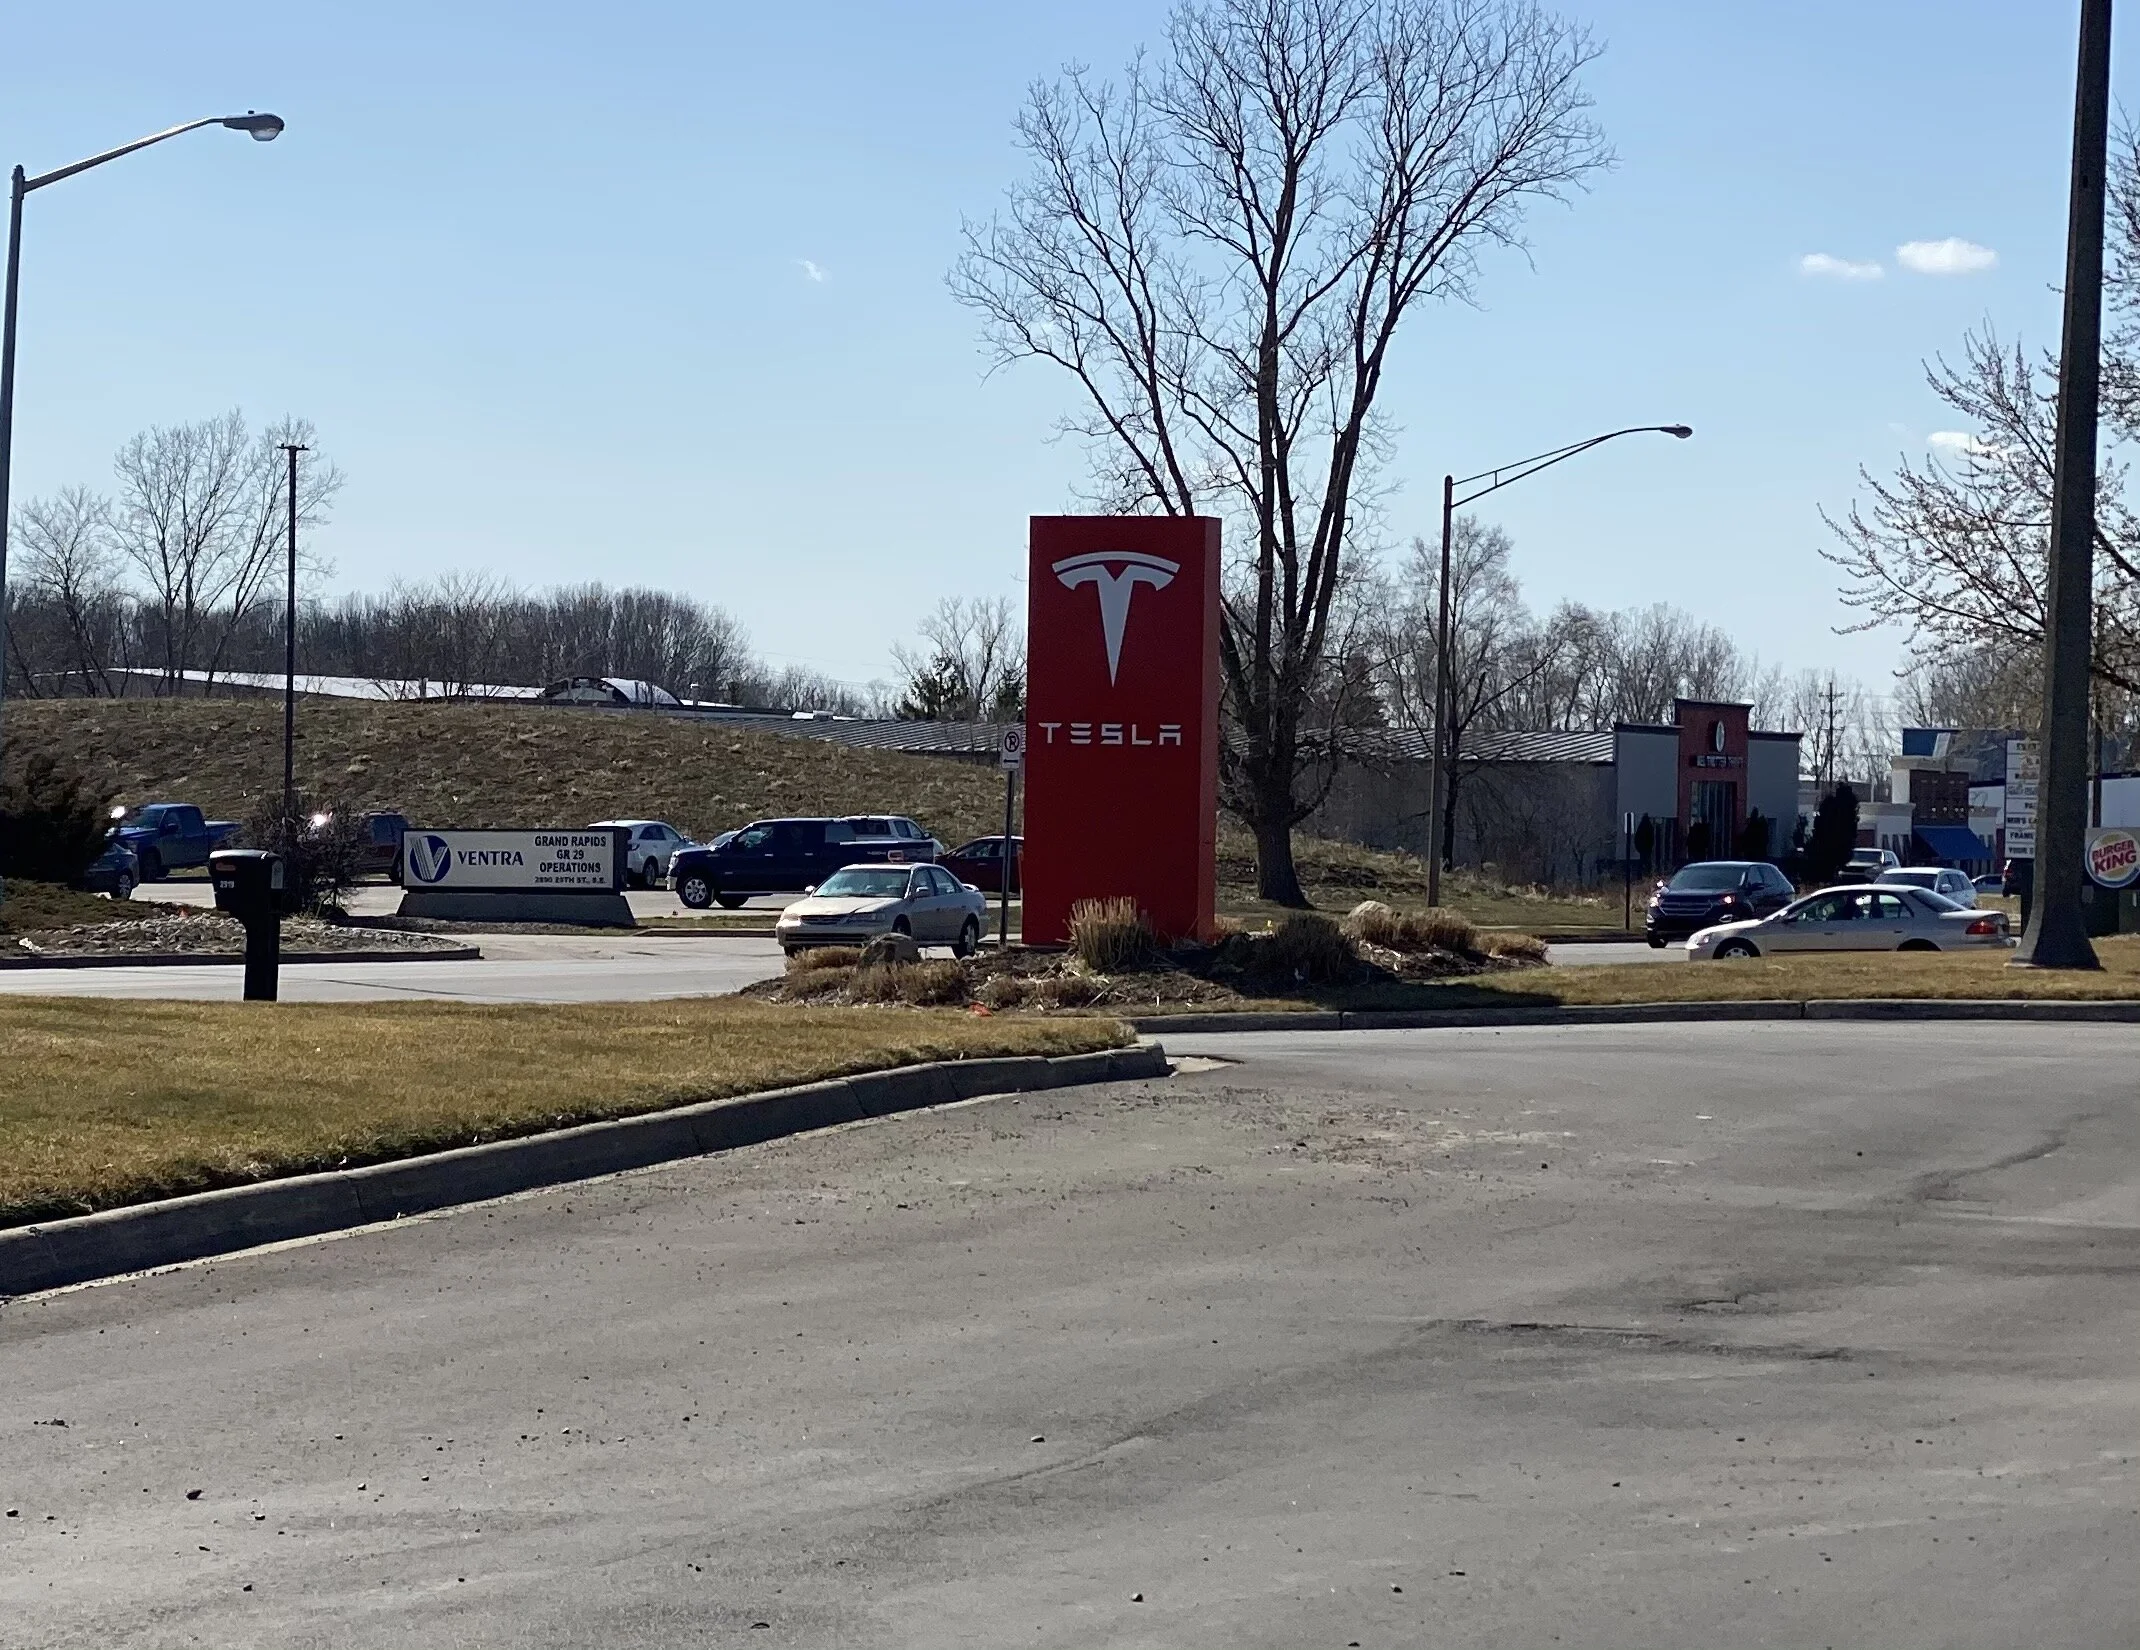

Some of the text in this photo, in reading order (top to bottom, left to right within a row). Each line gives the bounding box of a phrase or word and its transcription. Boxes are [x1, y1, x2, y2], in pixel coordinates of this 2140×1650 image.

[1038, 722, 1182, 746] TESLA
[534, 835, 607, 847] GRAND RAPIDS
[457, 850, 524, 866] VENTRA
[556, 849, 585, 860] GR 29
[2092, 839, 2135, 862] BURGER
[539, 862, 601, 873] OPERATIONS
[2094, 850, 2137, 875] KING
